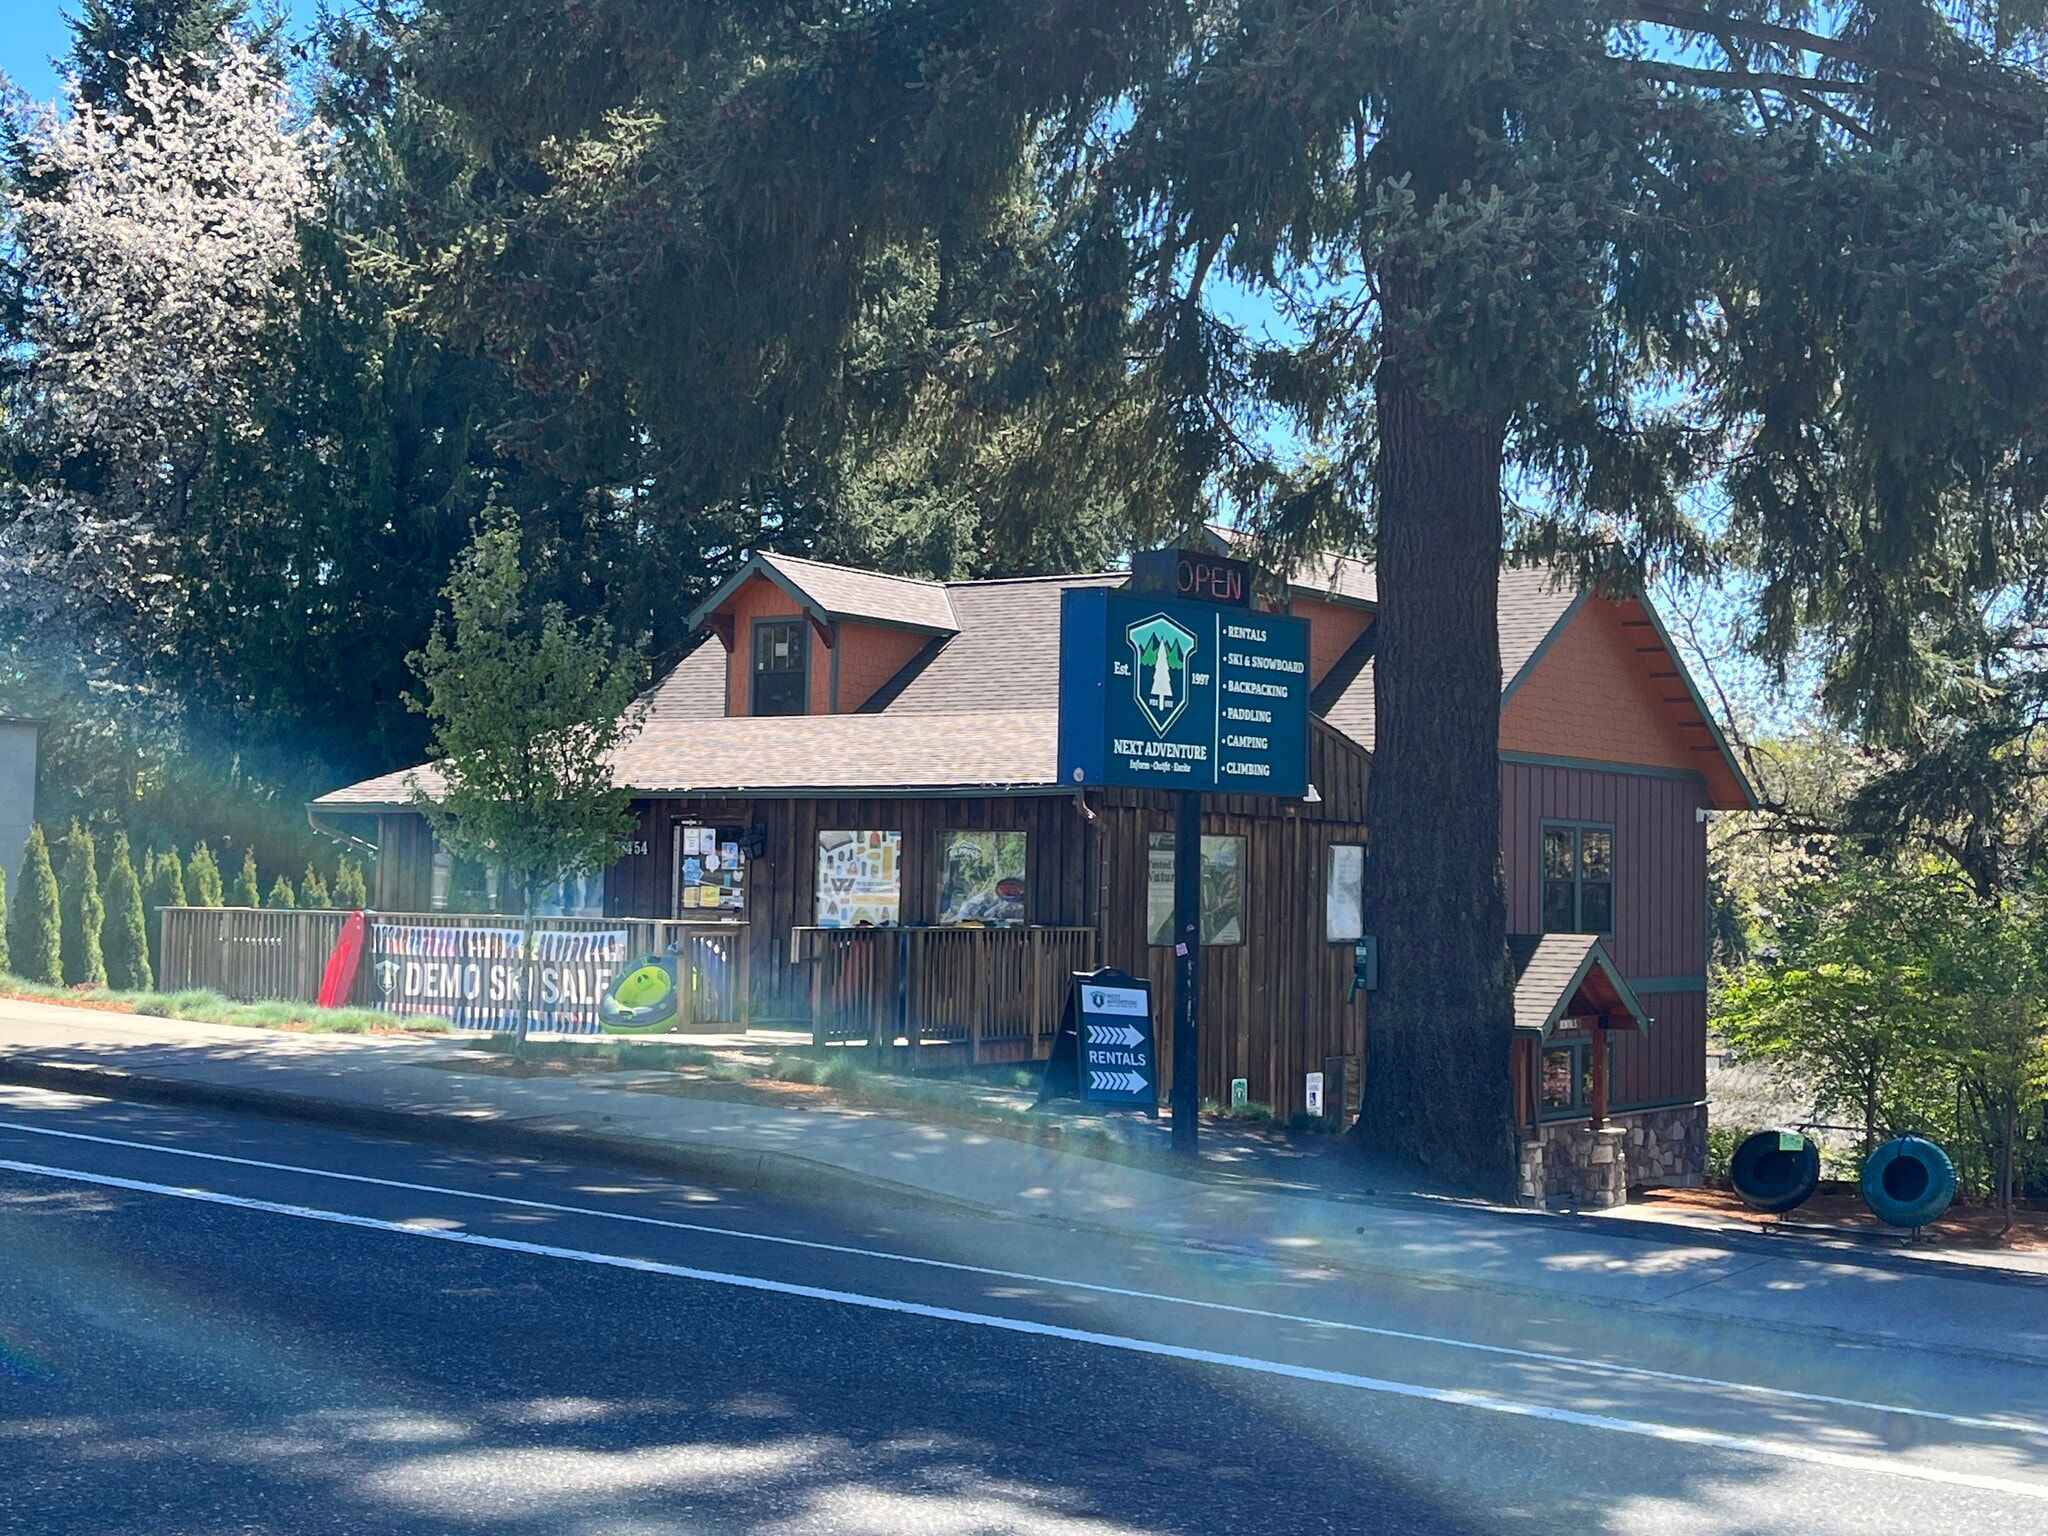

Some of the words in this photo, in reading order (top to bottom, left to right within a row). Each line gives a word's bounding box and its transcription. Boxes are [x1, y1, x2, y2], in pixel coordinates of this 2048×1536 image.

[1177, 560, 1242, 600] OPEN
[1227, 625, 1267, 642] RENTALS
[1113, 661, 1131, 676] Est.
[1228, 652, 1243, 666] SKI
[1244, 656, 1251, 667] &
[1251, 656, 1304, 674] SNOWBOARD
[1192, 672, 1210, 686] 1997
[1227, 680, 1288, 698] BACKPACKING
[1227, 707, 1272, 723] PADDLING
[1113, 739, 1144, 756] NEXT
[1144, 741, 1208, 760] ADVENTURE
[1226, 734, 1268, 750] CAMPING
[1226, 762, 1270, 777] CLIMBING
[404, 961, 481, 1000] DEMO
[490, 964, 533, 1001] SKI
[1089, 1050, 1147, 1067] RENTALS
